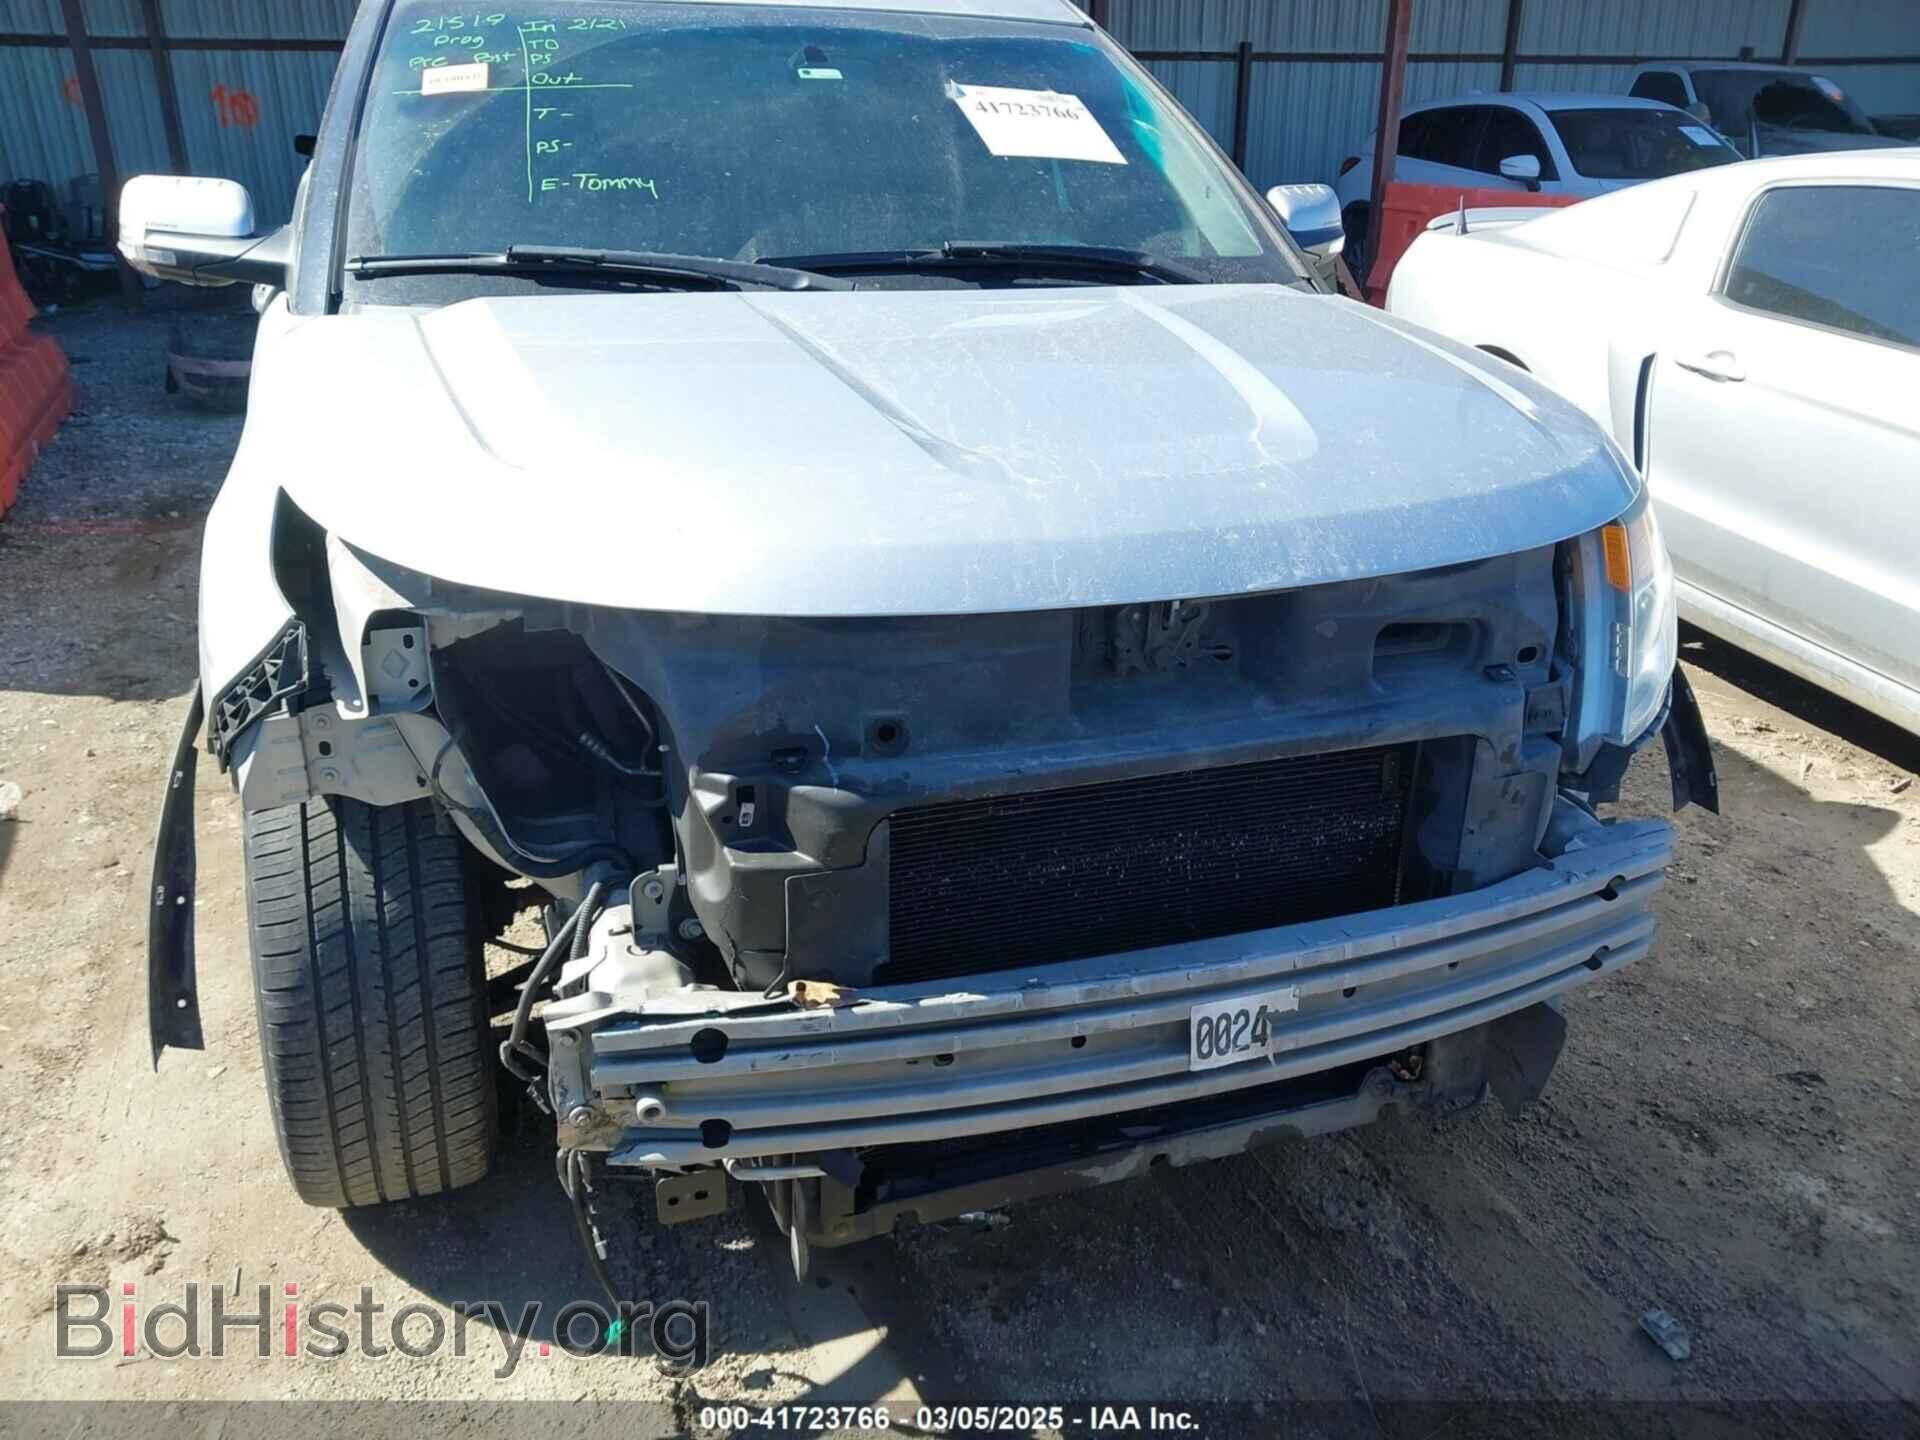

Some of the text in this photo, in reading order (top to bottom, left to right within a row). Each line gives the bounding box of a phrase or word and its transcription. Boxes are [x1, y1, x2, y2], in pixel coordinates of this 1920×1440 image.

[531, 72, 583, 85] Out
[975, 100, 1080, 120] 41723766
[1196, 1004, 1269, 1060] 0024
